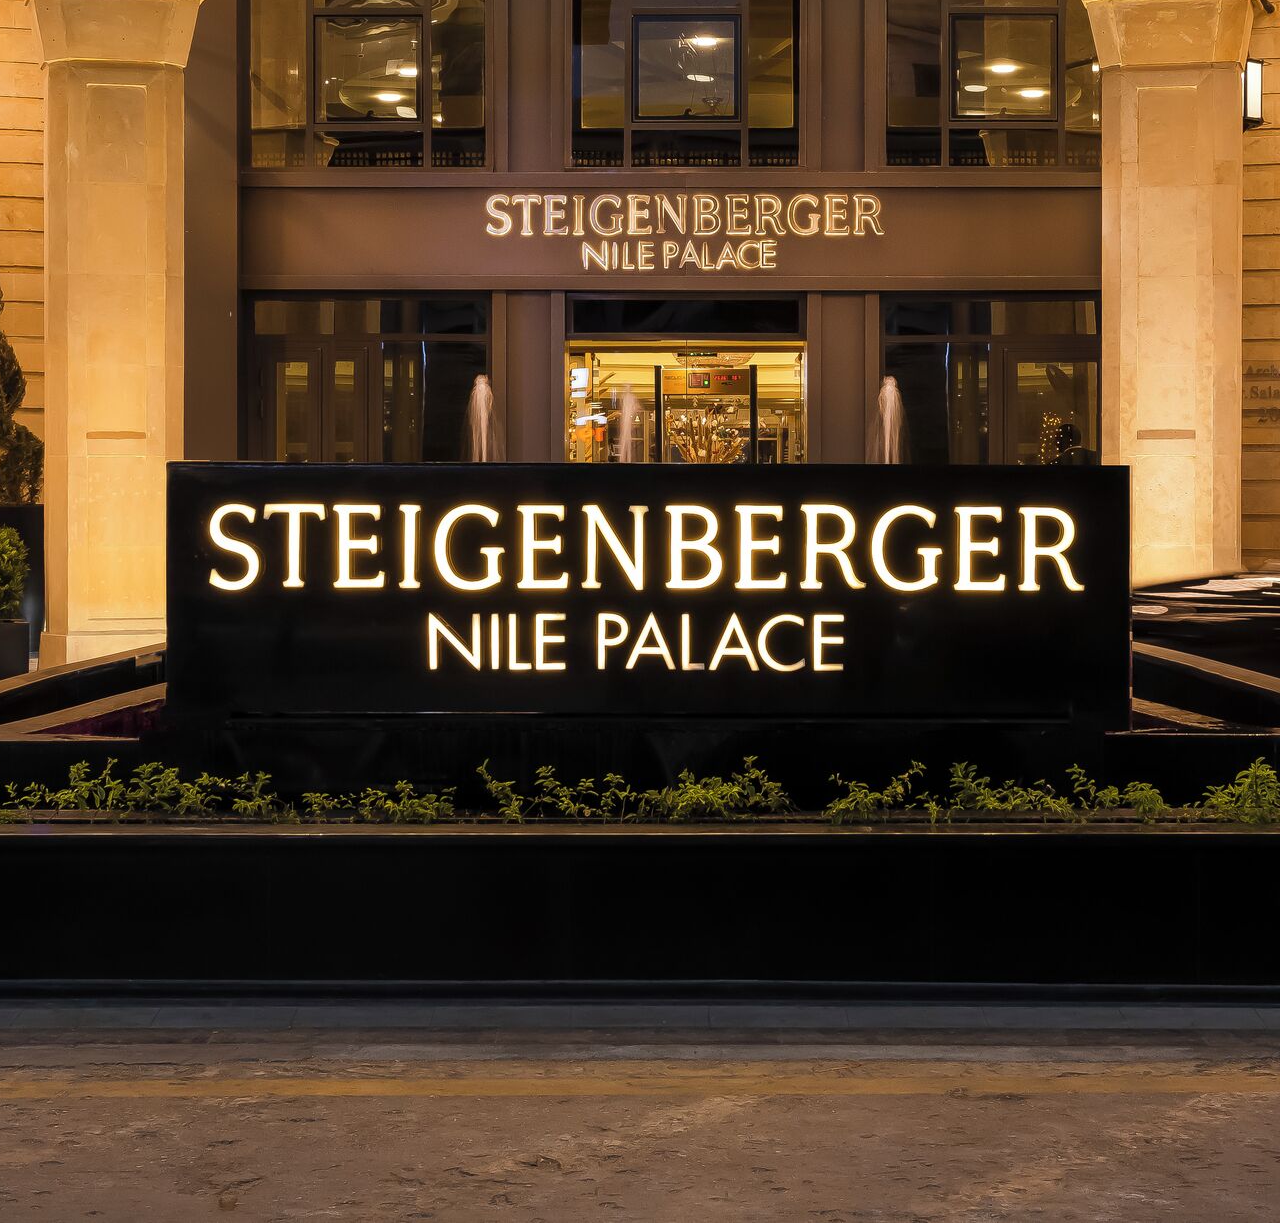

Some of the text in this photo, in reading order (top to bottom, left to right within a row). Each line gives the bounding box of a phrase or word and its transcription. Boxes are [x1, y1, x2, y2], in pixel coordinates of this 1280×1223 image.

[485, 193, 884, 237] STEIGENBERGER
[581, 239, 778, 271] NILE PALACE
[207, 501, 1086, 593] STEIGENBERGER
[426, 611, 846, 673] NILE PALACE
